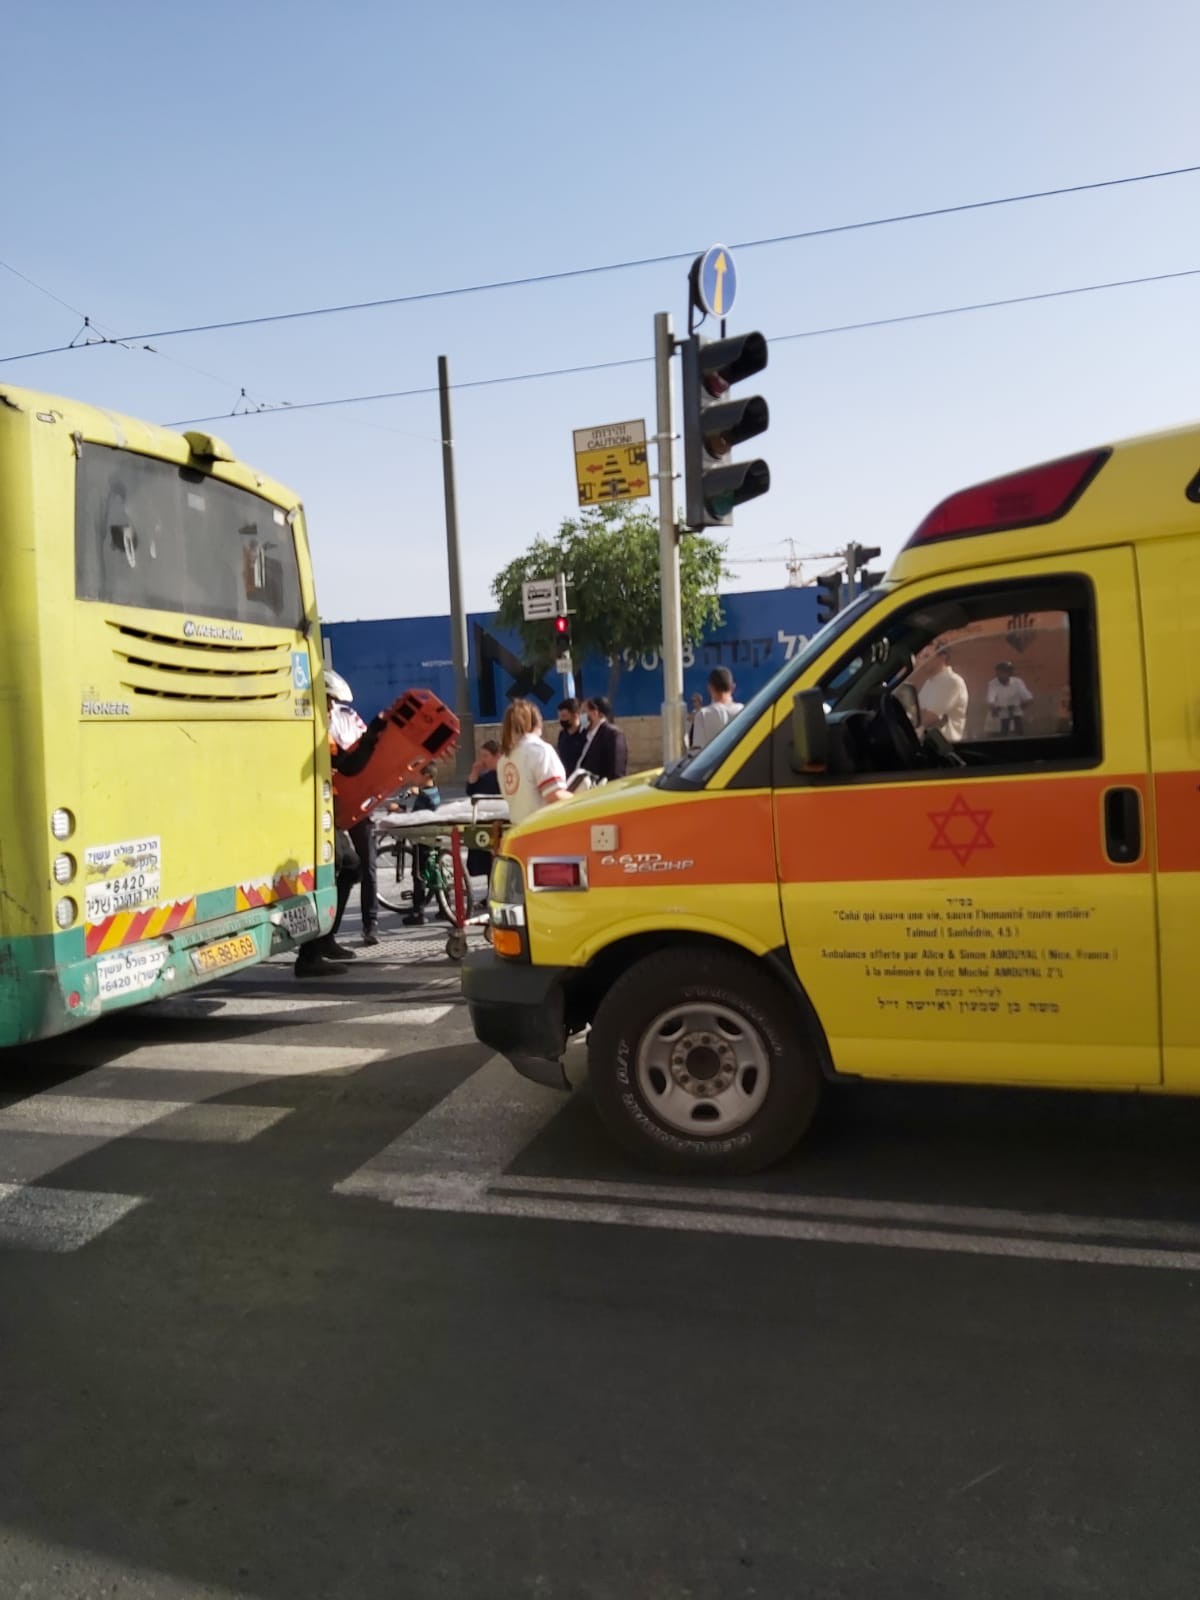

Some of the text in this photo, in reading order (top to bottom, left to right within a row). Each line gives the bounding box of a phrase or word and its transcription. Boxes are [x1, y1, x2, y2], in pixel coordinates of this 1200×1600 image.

[587, 436, 632, 448] CAUTION!
[704, 637, 773, 667] קנדה
[136, 840, 158, 853] הרכב
[863, 911, 875, 922] qui
[879, 912, 904, 921] sauve
[906, 927, 937, 938] Talmud
[821, 948, 866, 959] Ambulance
[870, 948, 900, 959] offerte
[904, 951, 918, 960] par
[922, 949, 944, 959] Alice
